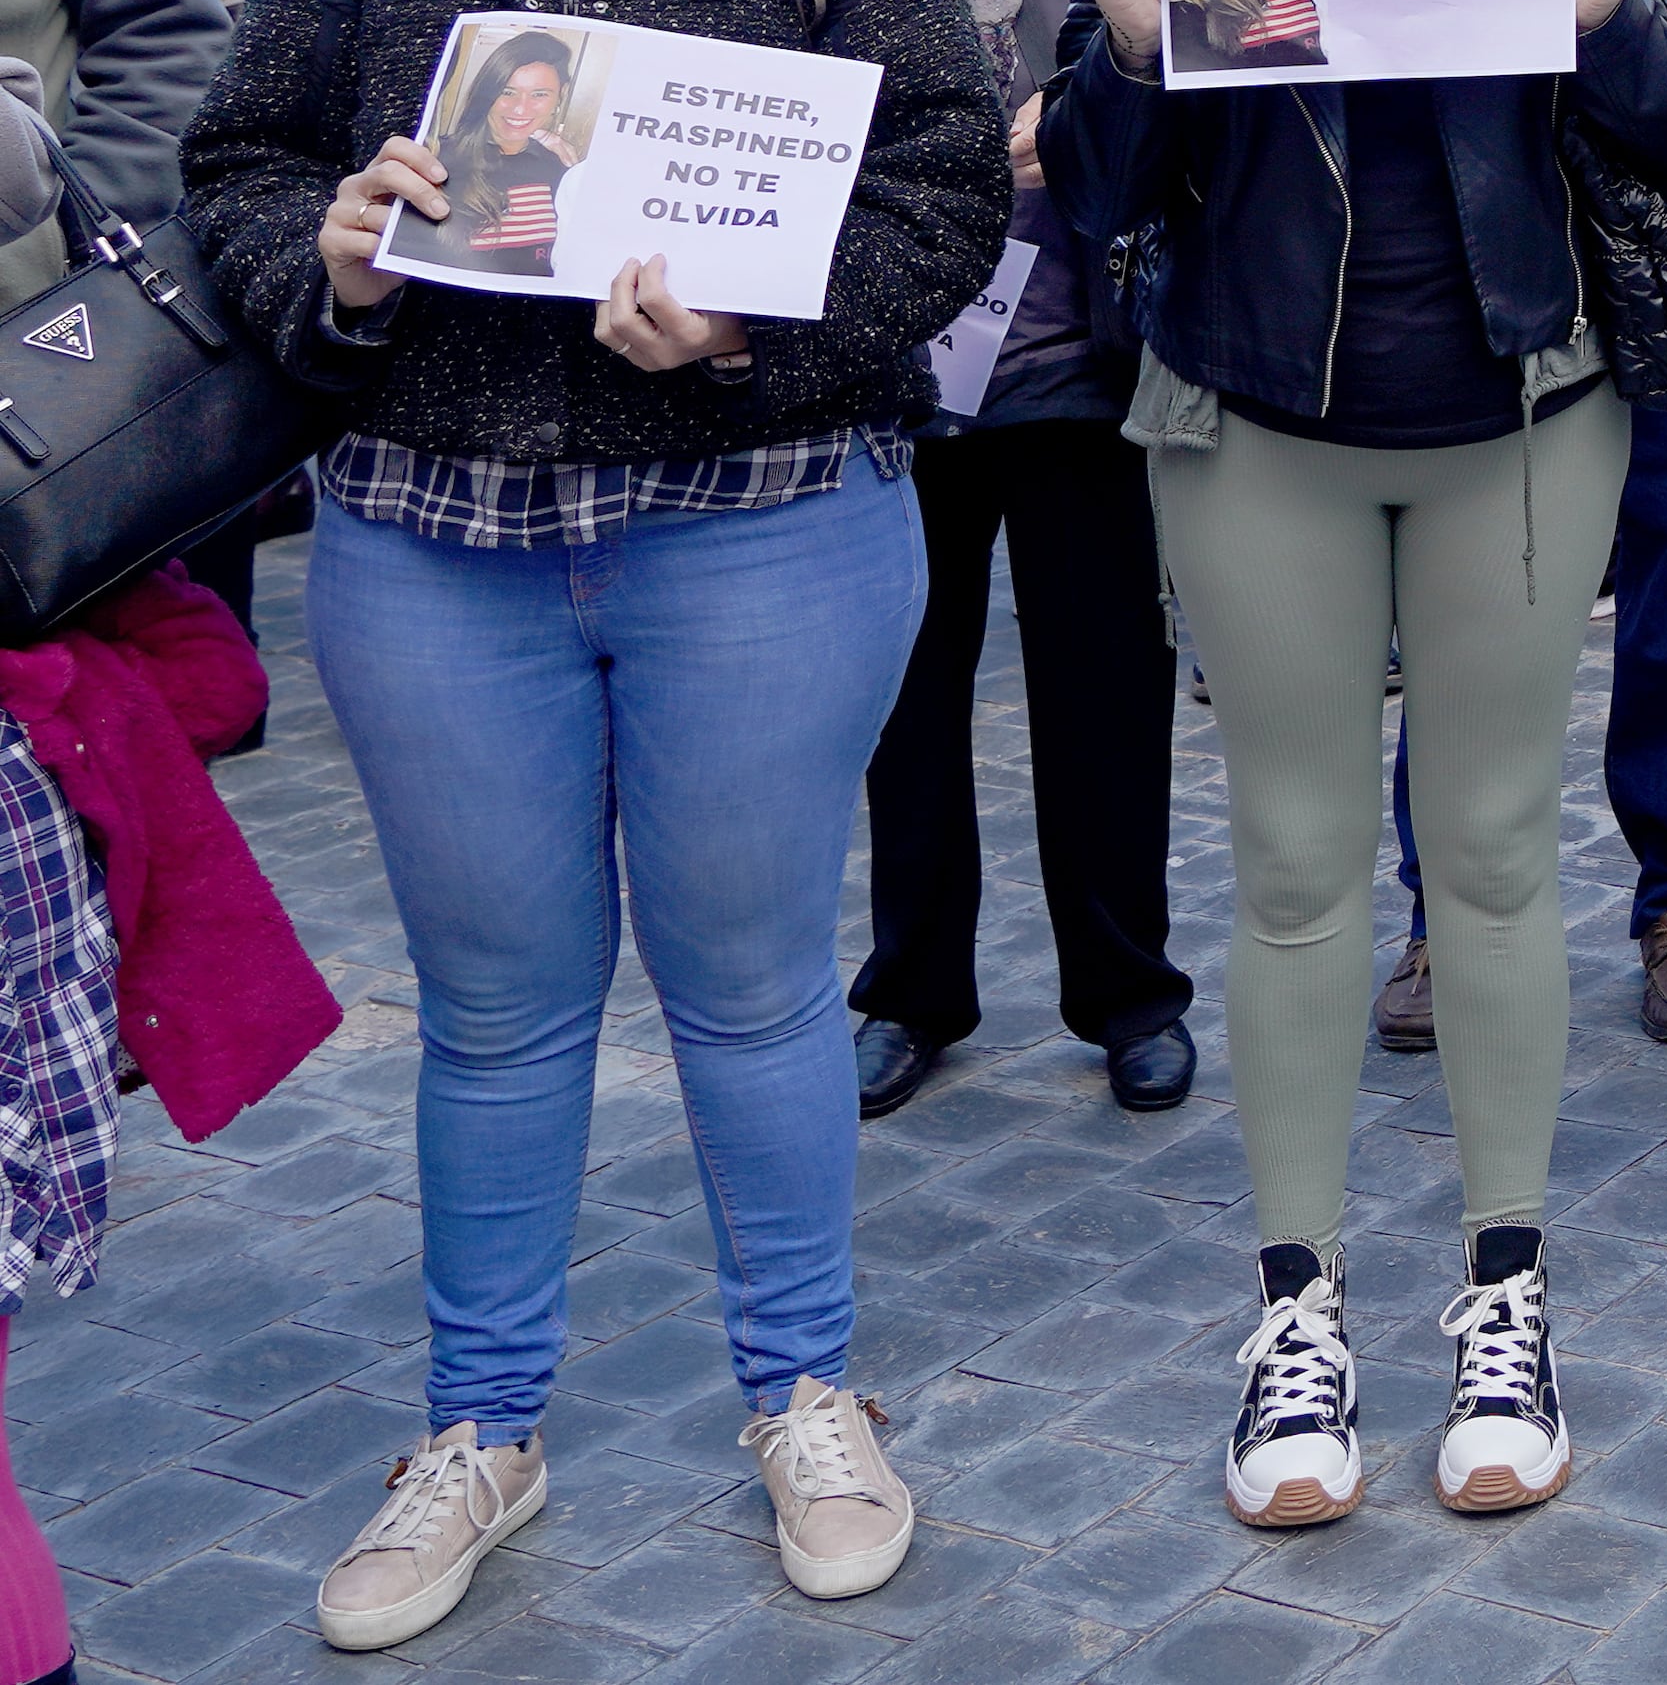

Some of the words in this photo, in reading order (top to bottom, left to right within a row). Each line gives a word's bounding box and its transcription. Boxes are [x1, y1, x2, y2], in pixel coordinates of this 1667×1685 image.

[661, 81, 819, 127] ESTHER,
[613, 112, 852, 163] TRASPINEDO
[665, 161, 719, 186] NO
[734, 170, 780, 193] TE
[642, 198, 779, 227] OLVIDA
[39, 312, 83, 343] GUESS
